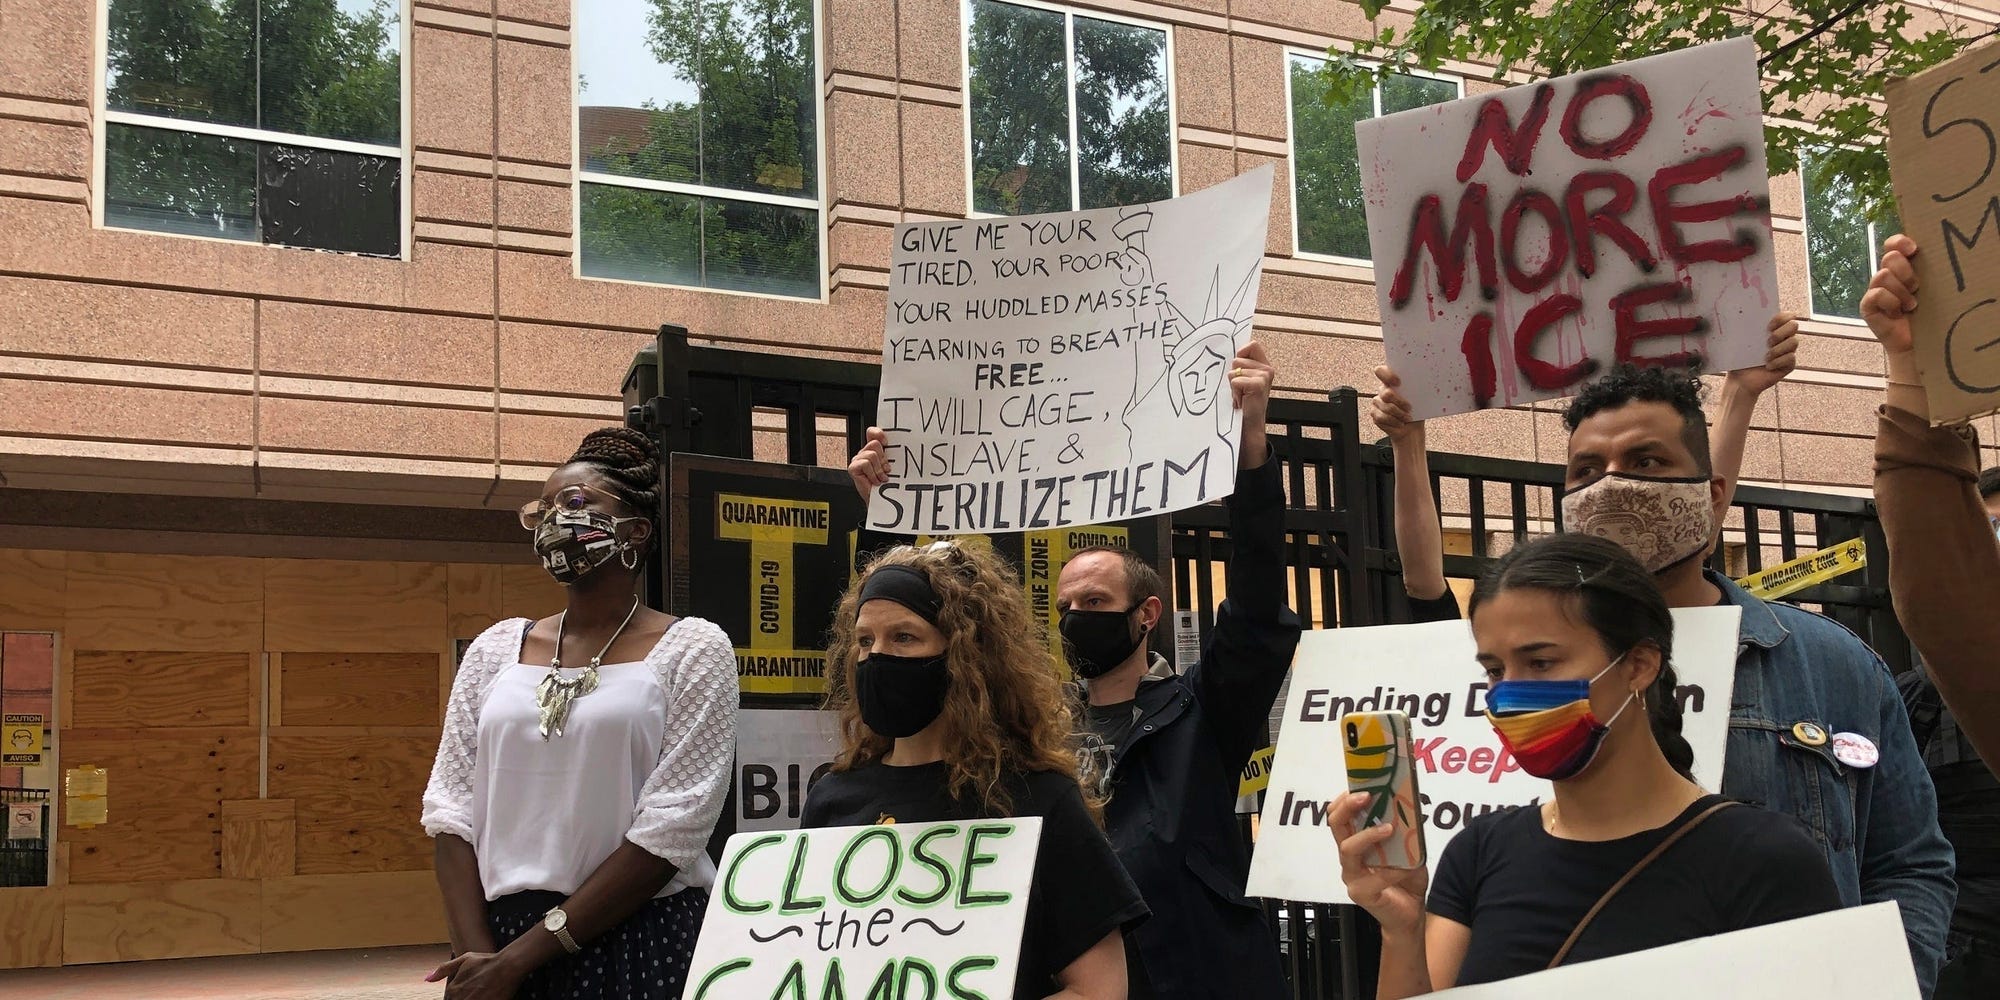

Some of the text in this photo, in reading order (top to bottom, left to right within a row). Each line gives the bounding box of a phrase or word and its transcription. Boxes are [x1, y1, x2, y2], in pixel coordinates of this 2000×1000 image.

[1456, 73, 1654, 183] NO
[902, 219, 1096, 252] GIVE ME YOUR
[1389, 145, 1769, 309] MORE
[898, 259, 977, 286] TIRED,
[992, 257, 1049, 278] YOUR
[894, 283, 1168, 324] YOUR HUDDLED MASSES
[889, 317, 1178, 364] YEARNING TO BREATHE
[1461, 282, 1708, 409] ICE
[975, 362, 1068, 390] FREE...
[883, 397, 914, 432] I
[918, 397, 992, 436] WILL
[1057, 432, 1084, 464] &
[873, 446, 1210, 531] STERILIZE THEM
[722, 501, 828, 530] QUARANTINE
[1031, 538, 1049, 579] ZONE
[1068, 531, 1127, 549] COVID-19
[1761, 551, 1840, 591] QUARANTINE ZONE
[760, 560, 780, 634] COVID-19
[737, 656, 826, 678] UARANTINE
[1299, 686, 1452, 727] Ending
[722, 824, 1016, 916] CLOSE
[814, 908, 895, 951] the
